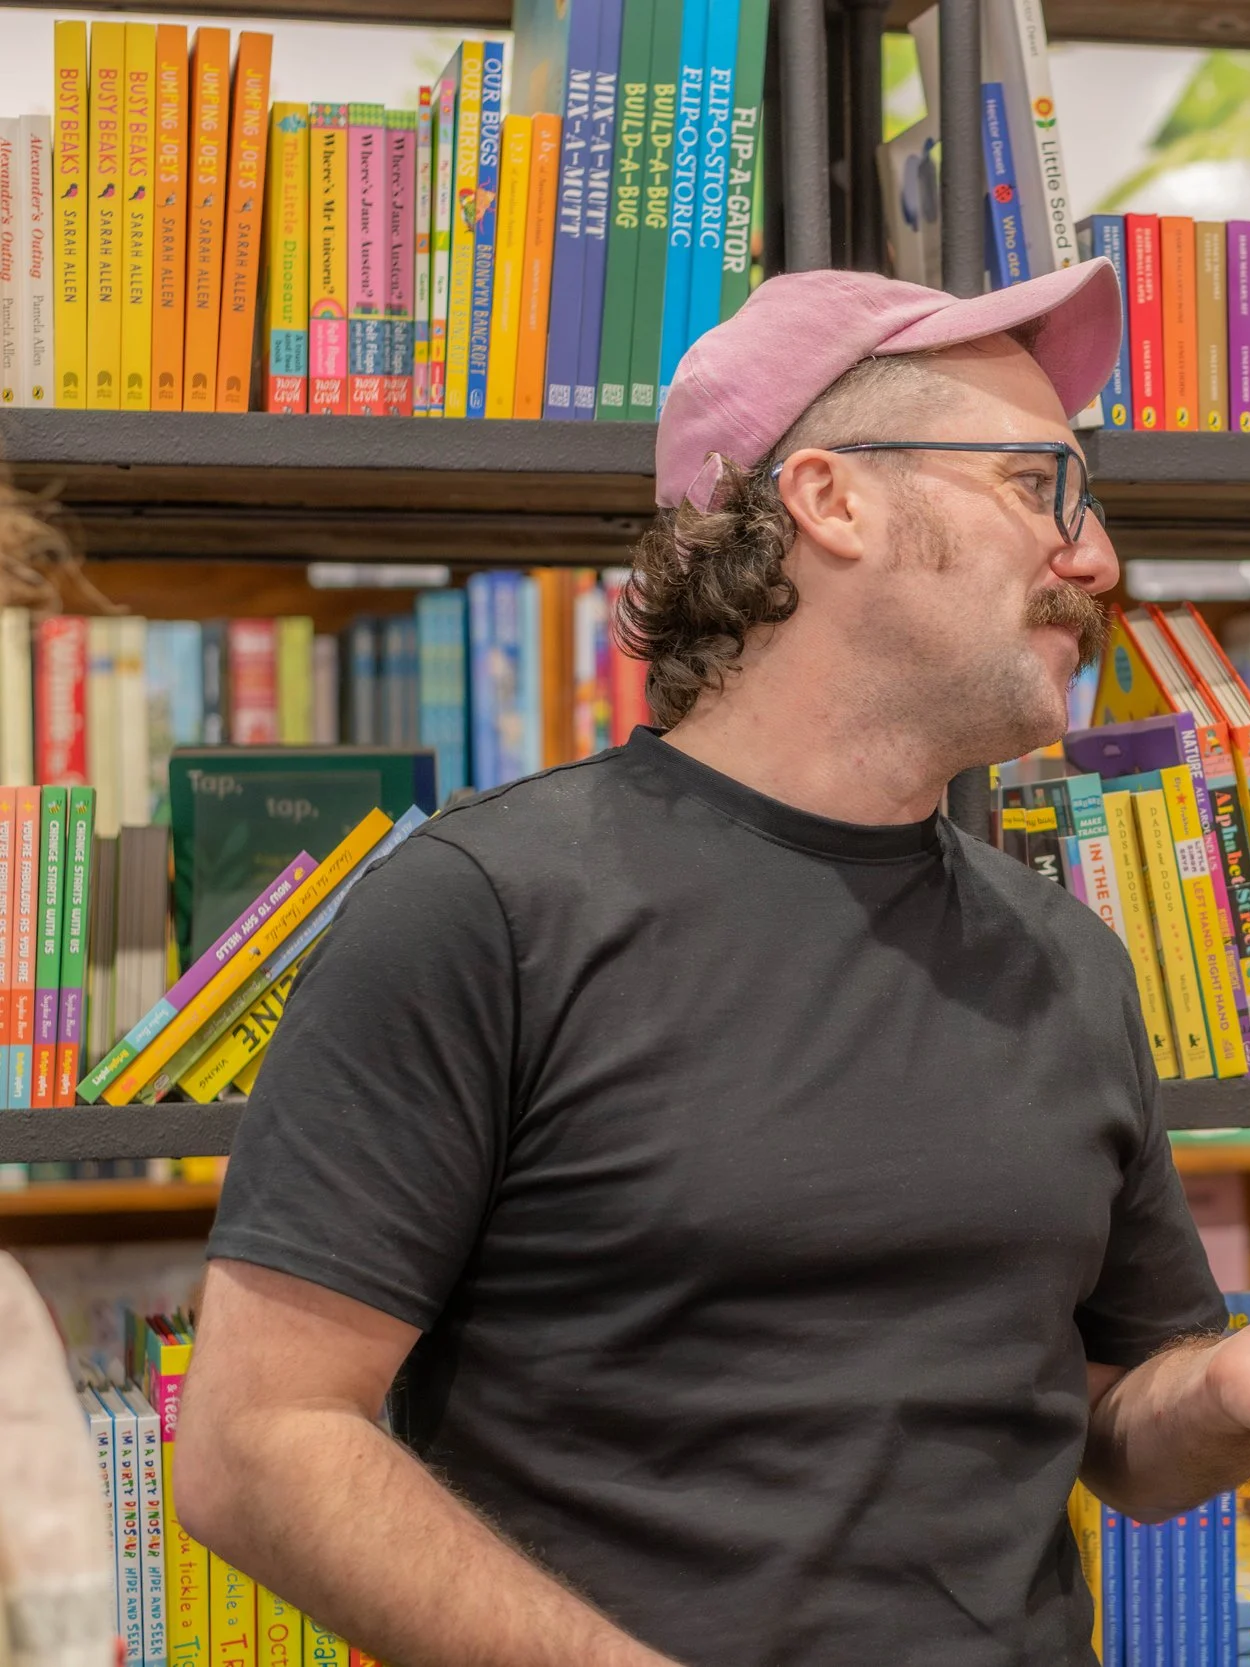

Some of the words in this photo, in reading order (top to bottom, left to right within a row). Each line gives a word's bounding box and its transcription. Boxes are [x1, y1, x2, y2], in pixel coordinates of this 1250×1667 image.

[60, 69, 79, 115] BUSY
[98, 69, 118, 115] BUSY
[161, 62, 179, 129] JUMPING
[462, 58, 481, 103] OUR
[483, 58, 502, 104] OUR
[60, 120, 79, 175] BEAKS
[98, 120, 118, 175] BEAKS
[160, 134, 179, 183] JOEYS
[284, 139, 298, 179] This
[459, 112, 479, 178] BIRDS
[481, 109, 499, 167] BUGS
[560, 69, 591, 238] MIX-A-MUTT
[585, 71, 617, 240] MIX-A-MUTT
[616, 83, 647, 229] BUILD-A-BUG
[645, 83, 676, 229] BUILD-A-BUG
[671, 64, 703, 248] FLIP-O-STORIC
[700, 66, 732, 249] FLIP-O-STORIC
[322, 133, 335, 195] Where's
[360, 134, 373, 195] Where's
[284, 184, 298, 235] Little
[323, 200, 335, 221] Mr
[722, 106, 757, 273] FLIP-A-GATOR
[1041, 141, 1061, 191] Little
[1051, 197, 1072, 249] Seed
[63, 209, 77, 256] SARAH
[99, 209, 113, 256] SARAH
[360, 198, 373, 234] Jane
[1002, 215, 1017, 249] Who
[30, 228, 44, 279] Outing
[161, 218, 175, 262] SARAH
[322, 225, 335, 294] Unicorn?
[64, 262, 77, 303] ALLEN
[99, 261, 112, 302] ALLEN
[283, 240, 297, 323] Dinosaur
[361, 241, 373, 297] Austen?
[474, 245, 493, 308] BRONWYN
[1007, 253, 1020, 277] ate
[161, 268, 174, 309] ALLEN
[33, 338, 45, 366] Allen
[469, 311, 491, 376] BANCROFT
[1180, 729, 1202, 781] NATURE
[1194, 786, 1204, 807] ALL
[21, 820, 33, 858] YOU'RE
[47, 820, 60, 864] CHANGE
[1078, 826, 1107, 837] TRACKS
[1080, 817, 1102, 827] MAKE
[1198, 806, 1213, 849] AROUND
[1215, 790, 1245, 887] Alphabet
[1089, 843, 1103, 862] IN
[1179, 848, 1189, 873] SAYS
[1186, 844, 1197, 873] SIMON
[1195, 840, 1206, 873] LITTLE
[1209, 850, 1217, 872] US
[20, 860, 32, 915] FABULOUS
[45, 864, 58, 905] STARTS
[270, 879, 292, 905] HOW
[1094, 866, 1109, 900] THE
[1192, 881, 1203, 905] LEFT
[19, 917, 30, 933] AS
[45, 907, 56, 937] WITH
[241, 913, 261, 934] SAY
[257, 901, 272, 917] TO
[1198, 904, 1215, 952] HAND,
[18, 933, 30, 958] YOU
[44, 938, 54, 956] US
[215, 930, 243, 961] HELLO
[18, 959, 29, 983] ARE
[1206, 954, 1222, 989] RIGHT
[1213, 989, 1230, 1032] HAND
[198, 1058, 229, 1090] VIKING
[121, 1448, 132, 1458] A
[121, 1461, 134, 1496] DIRTY
[122, 1501, 137, 1559] DINOSAUR
[125, 1567, 137, 1594] HIDE
[179, 1562, 197, 1612] tickle
[127, 1597, 138, 1620] AND
[182, 1619, 192, 1628] a
[127, 1624, 139, 1656] SEEK
